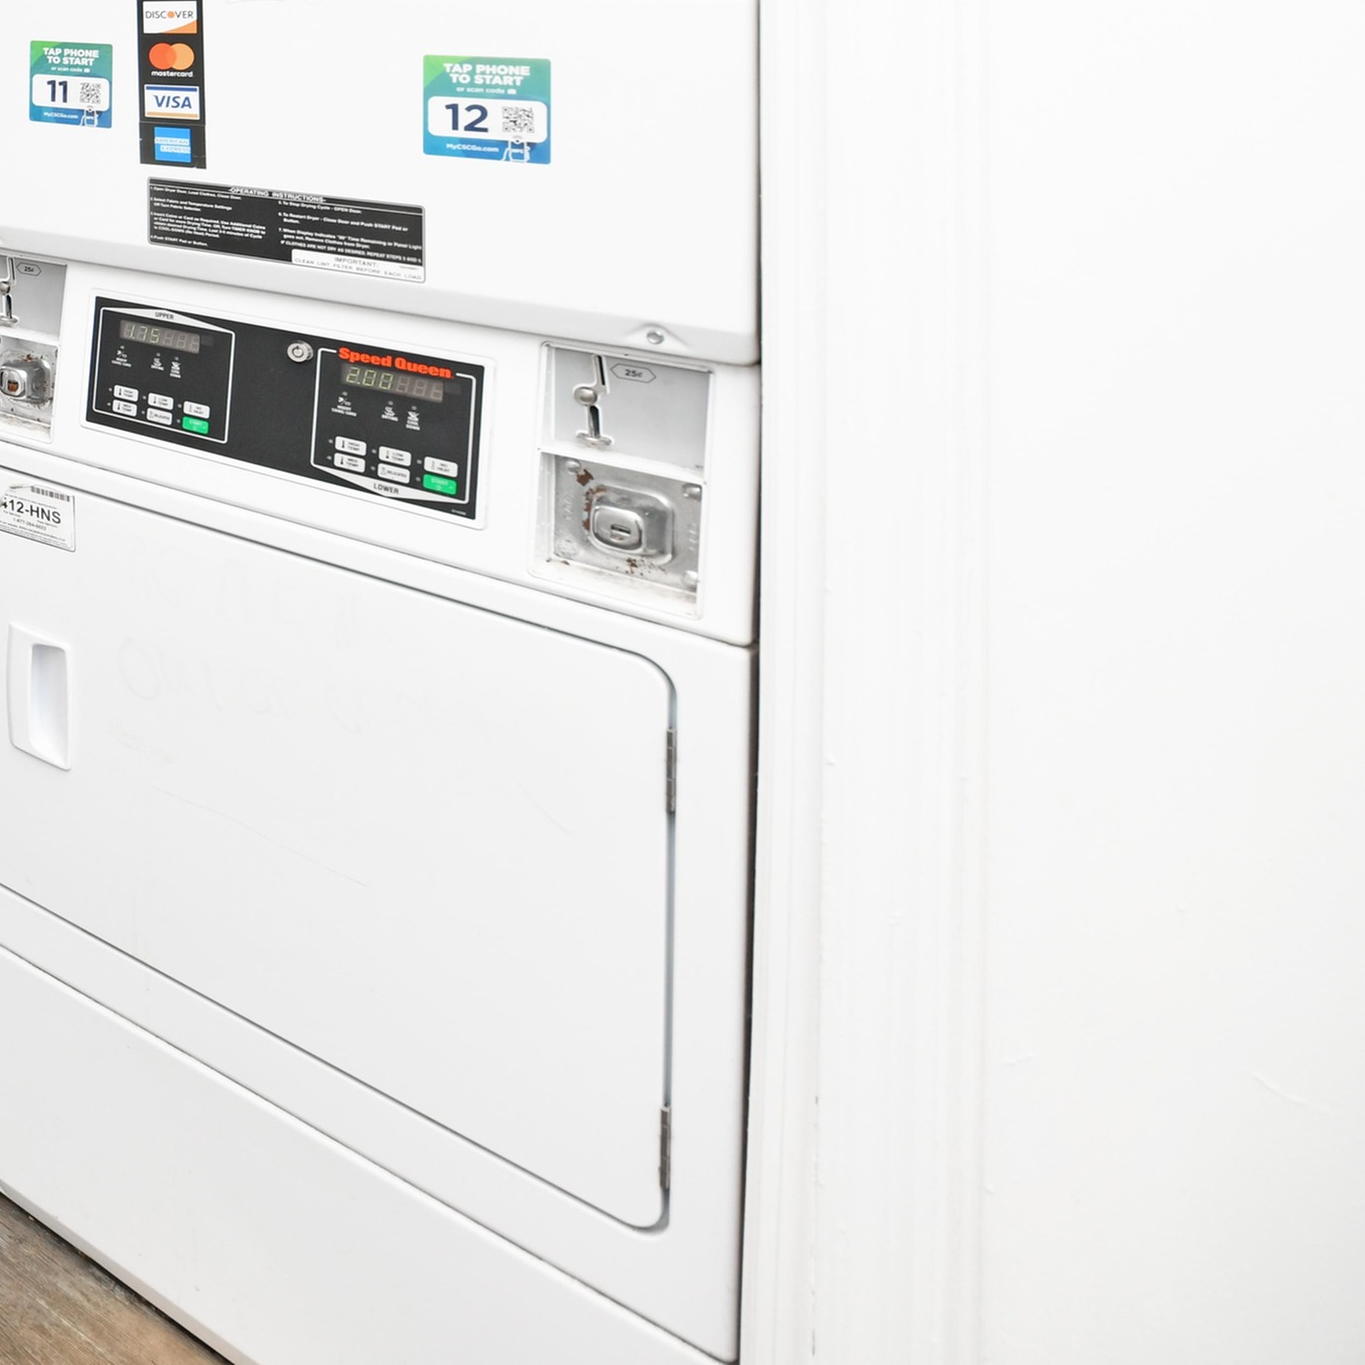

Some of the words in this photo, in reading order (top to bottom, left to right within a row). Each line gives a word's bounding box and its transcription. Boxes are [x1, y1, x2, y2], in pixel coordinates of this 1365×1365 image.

[145, 10, 194, 20] DISCOVER
[43, 47, 62, 56] TAP
[63, 48, 100, 58] PHONE
[47, 55, 61, 64] TO
[62, 56, 95, 66] START
[151, 70, 194, 78] mastercard
[443, 63, 473, 74] TAP
[475, 64, 531, 76] PHONE
[449, 73, 471, 84] TO
[474, 74, 524, 86] START
[46, 79, 68, 103] 11
[153, 95, 193, 109] VISA
[444, 103, 489, 133] 12
[154, 311, 175, 321] UPPER
[338, 347, 392, 368] Speed
[394, 357, 453, 379] Queen
[346, 366, 394, 391] 2.00
[625, 369, 643, 379] 25¢
[373, 483, 400, 495] LOWER
